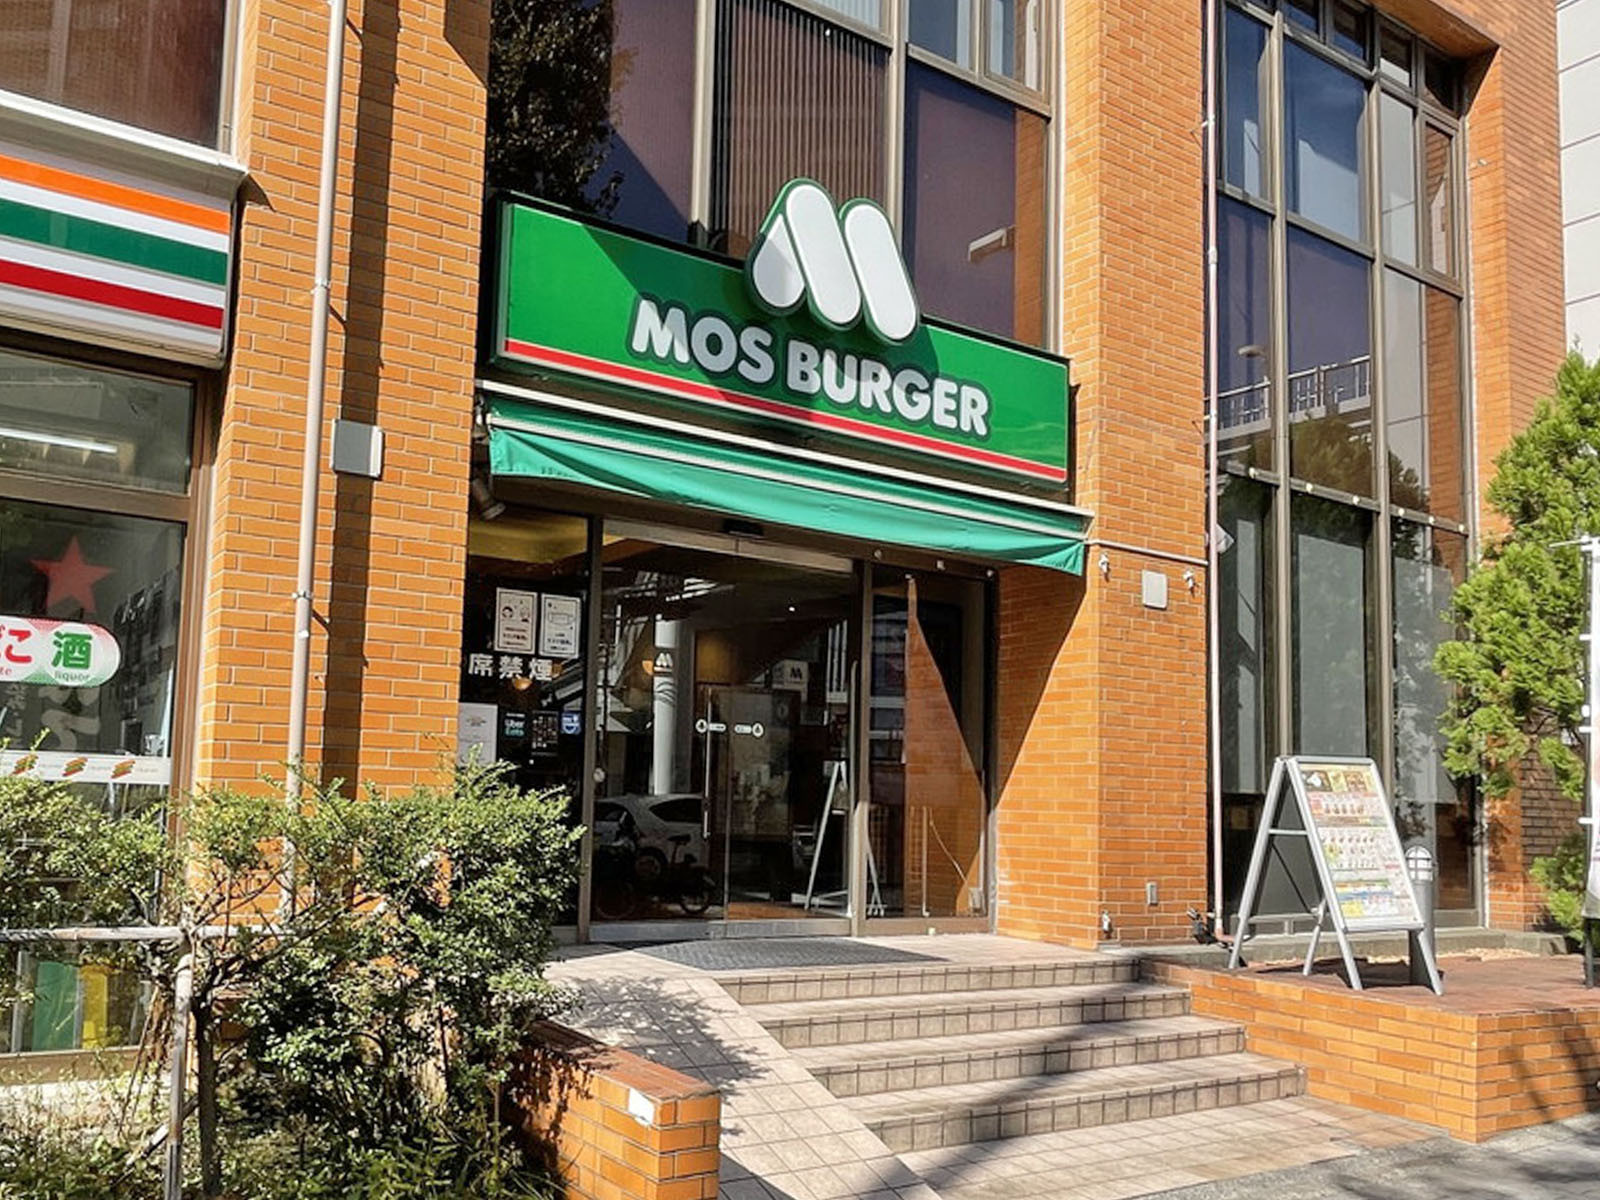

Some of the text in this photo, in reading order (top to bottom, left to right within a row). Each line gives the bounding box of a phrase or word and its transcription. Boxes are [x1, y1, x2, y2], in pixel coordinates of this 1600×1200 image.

[630, 298, 989, 437] MOS BURGER
[0, 624, 93, 669] こ 酒
